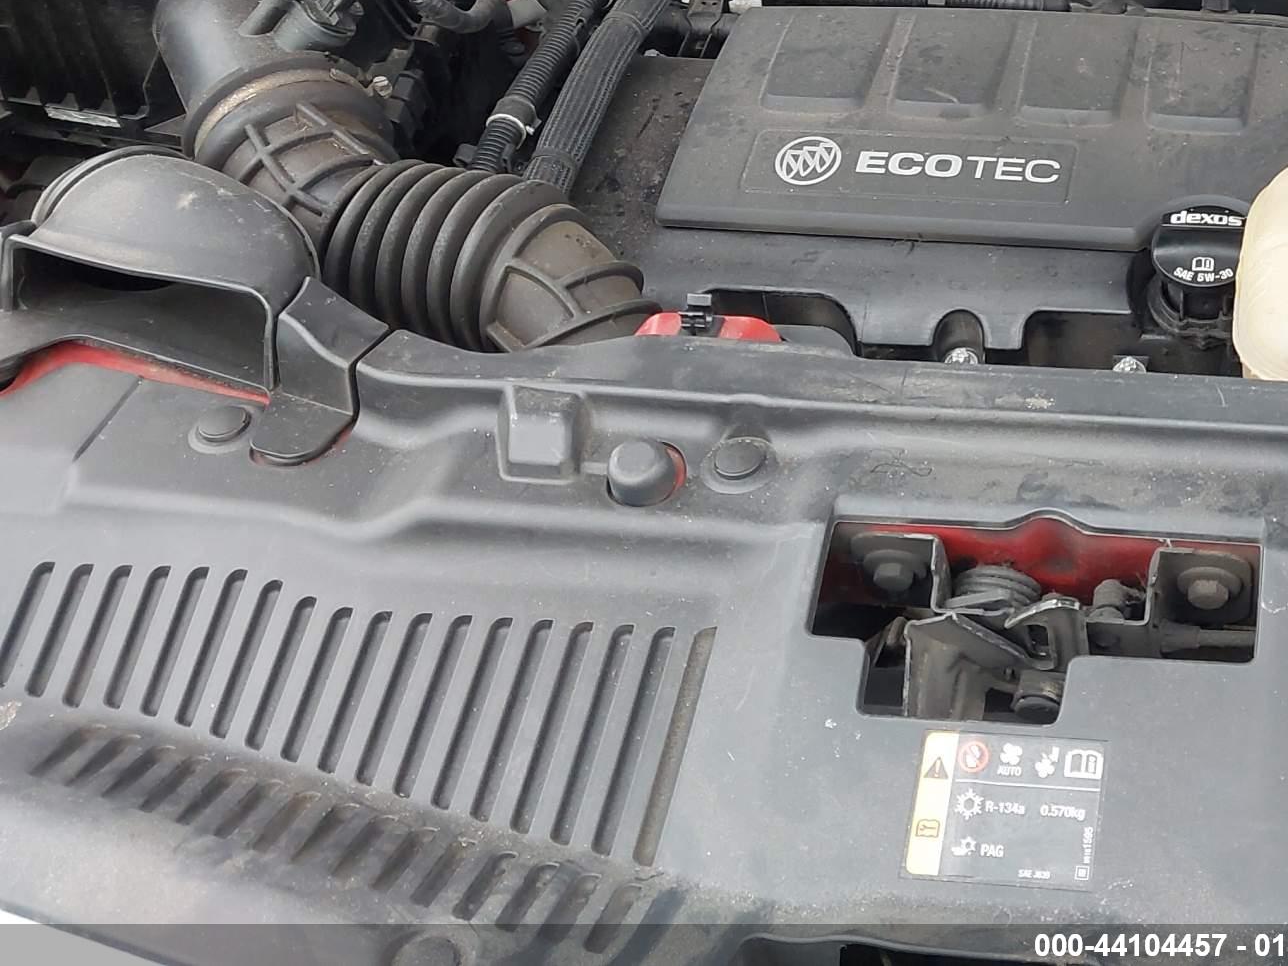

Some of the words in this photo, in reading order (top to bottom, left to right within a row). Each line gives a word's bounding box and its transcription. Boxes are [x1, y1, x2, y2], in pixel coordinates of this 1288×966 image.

[1170, 210, 1245, 227] dexos
[1173, 267, 1195, 281] SAE
[1197, 268, 1234, 282] 5W-30
[996, 765, 1022, 777] AUTO
[985, 800, 1026, 815] R-134a
[980, 843, 1005, 858] PAG
